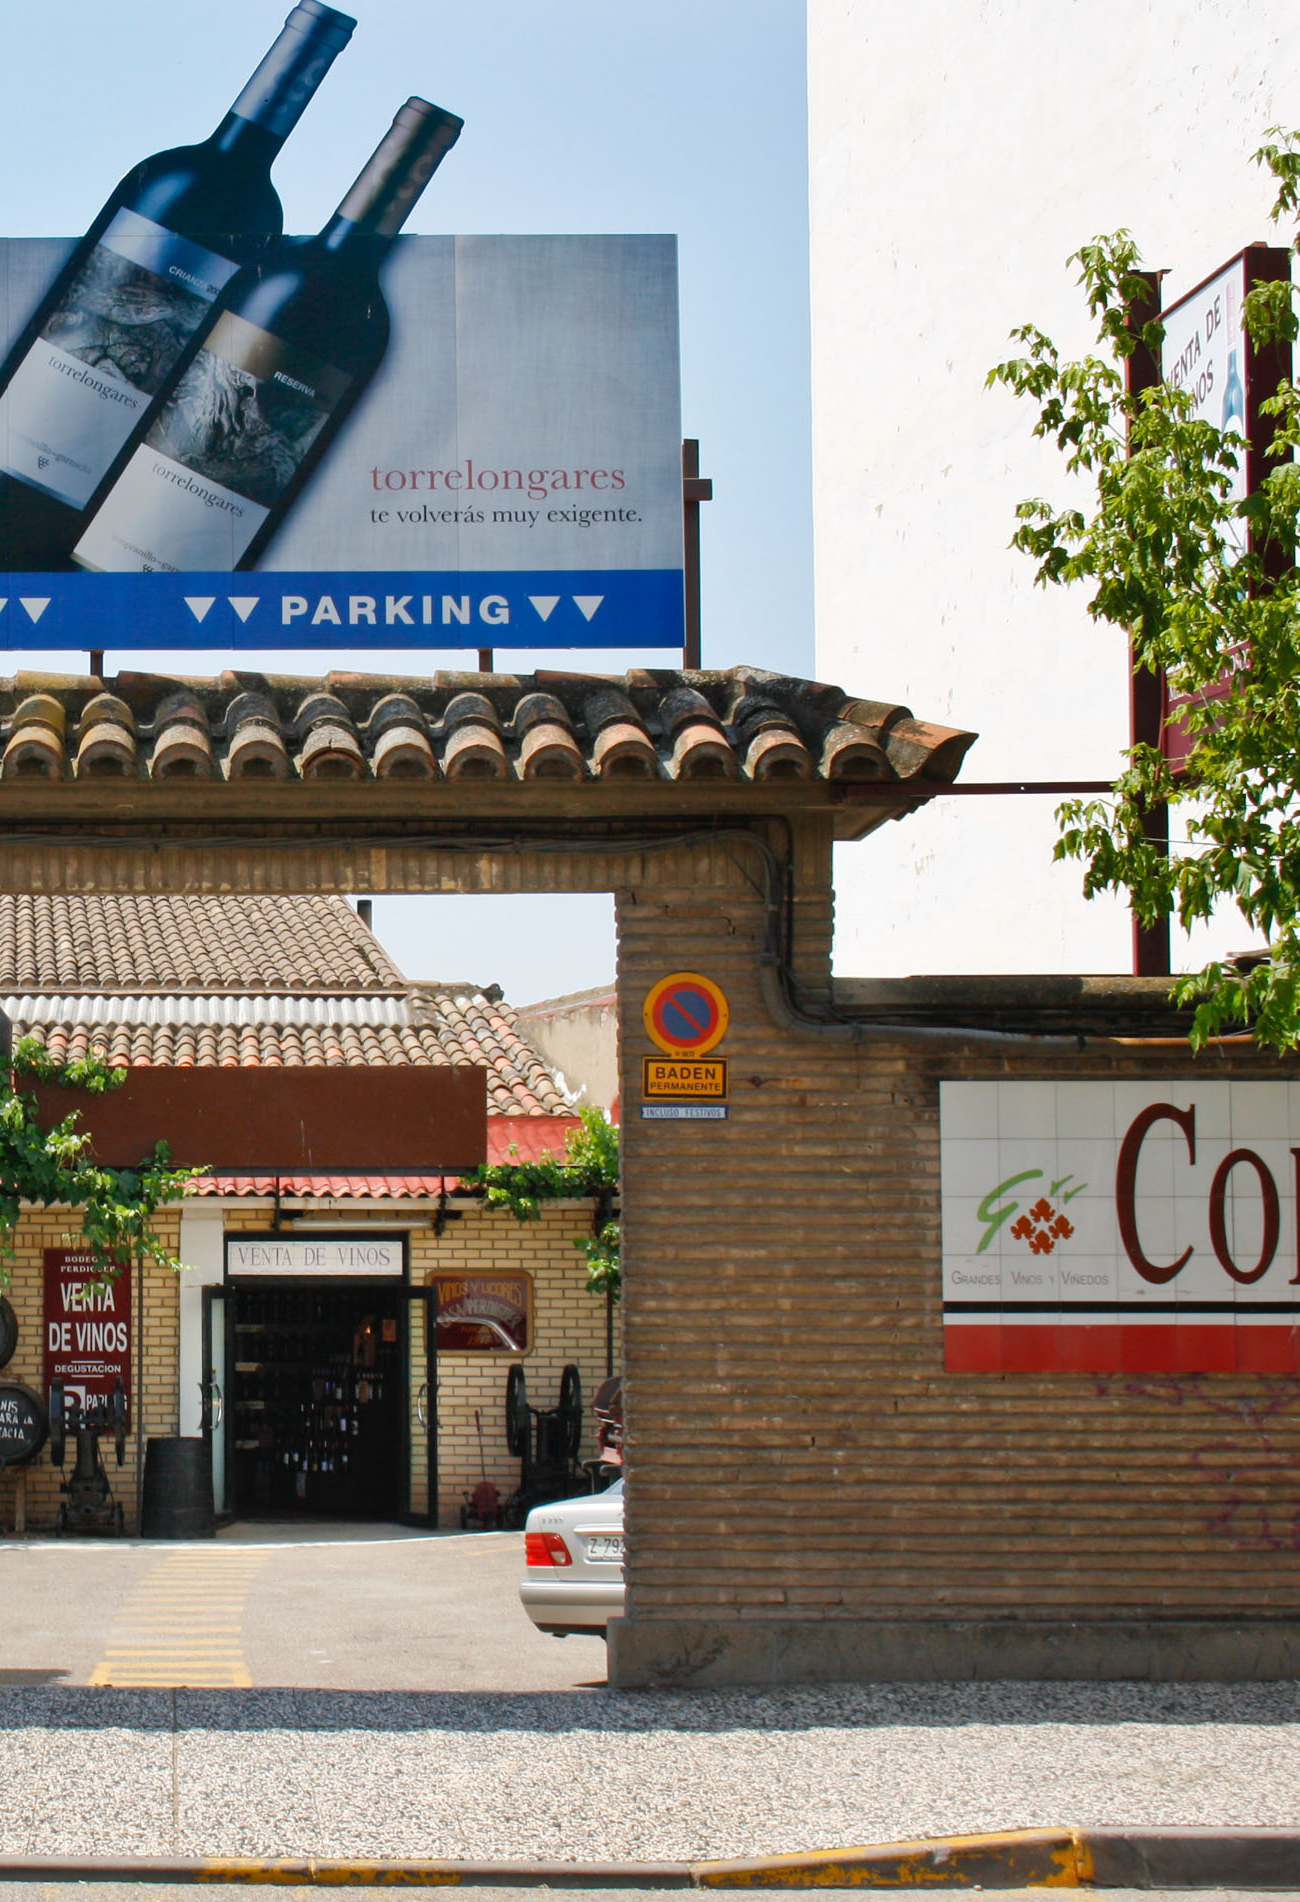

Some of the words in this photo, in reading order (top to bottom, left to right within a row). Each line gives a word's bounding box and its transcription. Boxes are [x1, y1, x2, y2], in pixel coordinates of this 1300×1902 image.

[1206, 293, 1221, 344] DE
[47, 355, 141, 410] torrelongares
[273, 371, 316, 398] RESERVA
[151, 461, 246, 519] torrelongares
[370, 460, 626, 500] torrelongares
[370, 506, 389, 523] te
[399, 504, 485, 523] volverás
[492, 510, 539, 528] muy
[547, 506, 642, 528] exigente.
[281, 595, 510, 626] PARKING
[655, 1066, 716, 1079] BADEN
[650, 1082, 721, 1091] PERMANENTE
[646, 1108, 680, 1117] INCLUSO
[685, 1108, 722, 1117] FESTIVOS
[1116, 1102, 1300, 1285] CO
[238, 1247, 293, 1266] VENTA
[303, 1247, 327, 1266] DE
[337, 1247, 391, 1266] VINOS
[951, 1270, 1001, 1285] GRANDES
[1010, 1271, 1043, 1285] VINOS
[49, 1322, 72, 1352] DE
[75, 1322, 128, 1352] VINOS
[54, 1364, 122, 1373] DEGUSTACION
